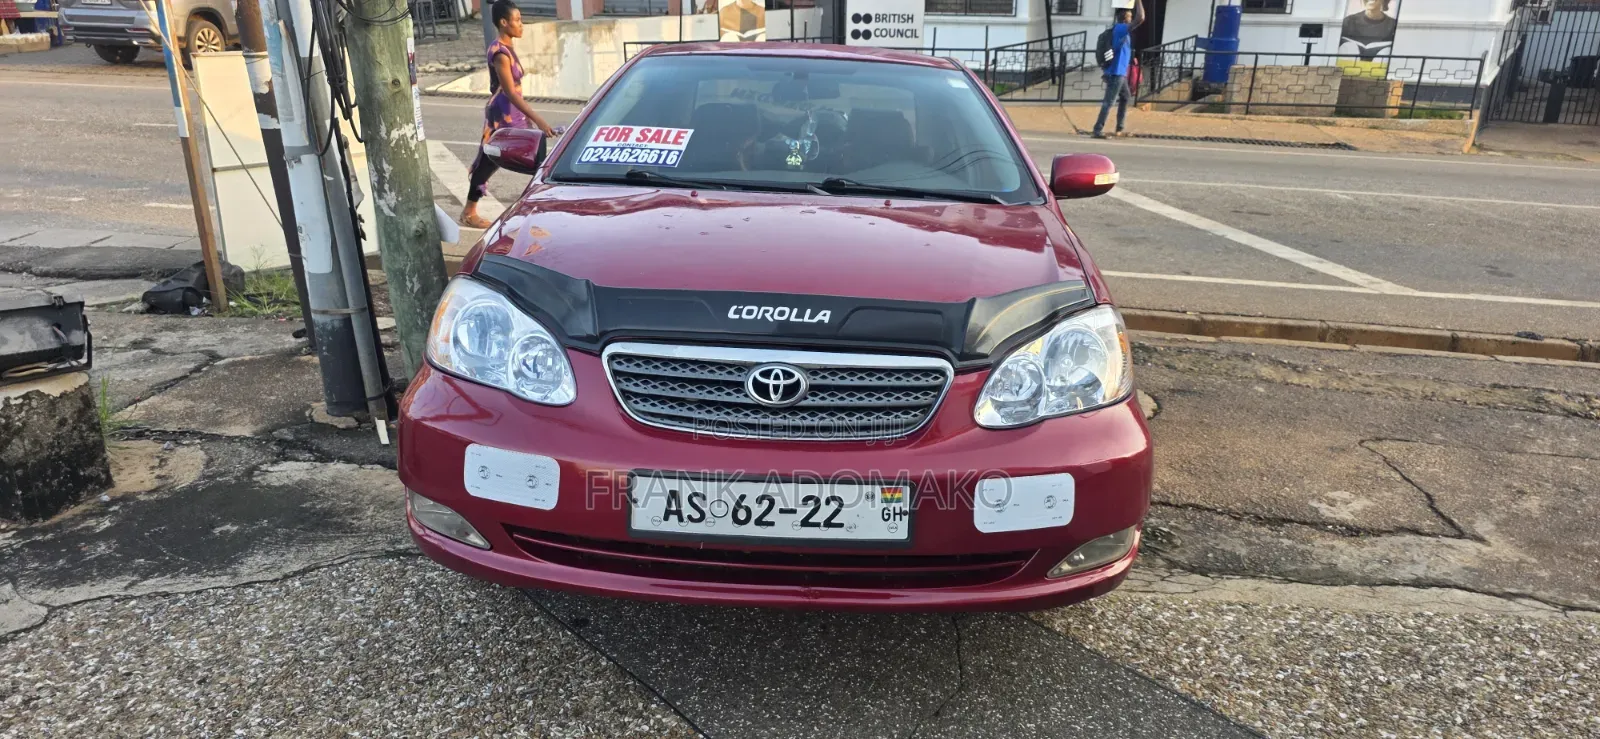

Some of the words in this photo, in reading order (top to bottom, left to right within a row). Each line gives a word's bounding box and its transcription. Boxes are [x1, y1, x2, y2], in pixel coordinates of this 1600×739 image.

[874, 13, 914, 24] BRITISH
[874, 28, 919, 39] COUNCIL
[593, 126, 633, 142] FOR
[635, 127, 688, 145] SALE
[580, 147, 678, 165] 0244626616
[727, 305, 832, 324] COROLLA
[662, 489, 706, 523] AS
[731, 493, 845, 529] 62-22
[881, 506, 903, 522] GH
